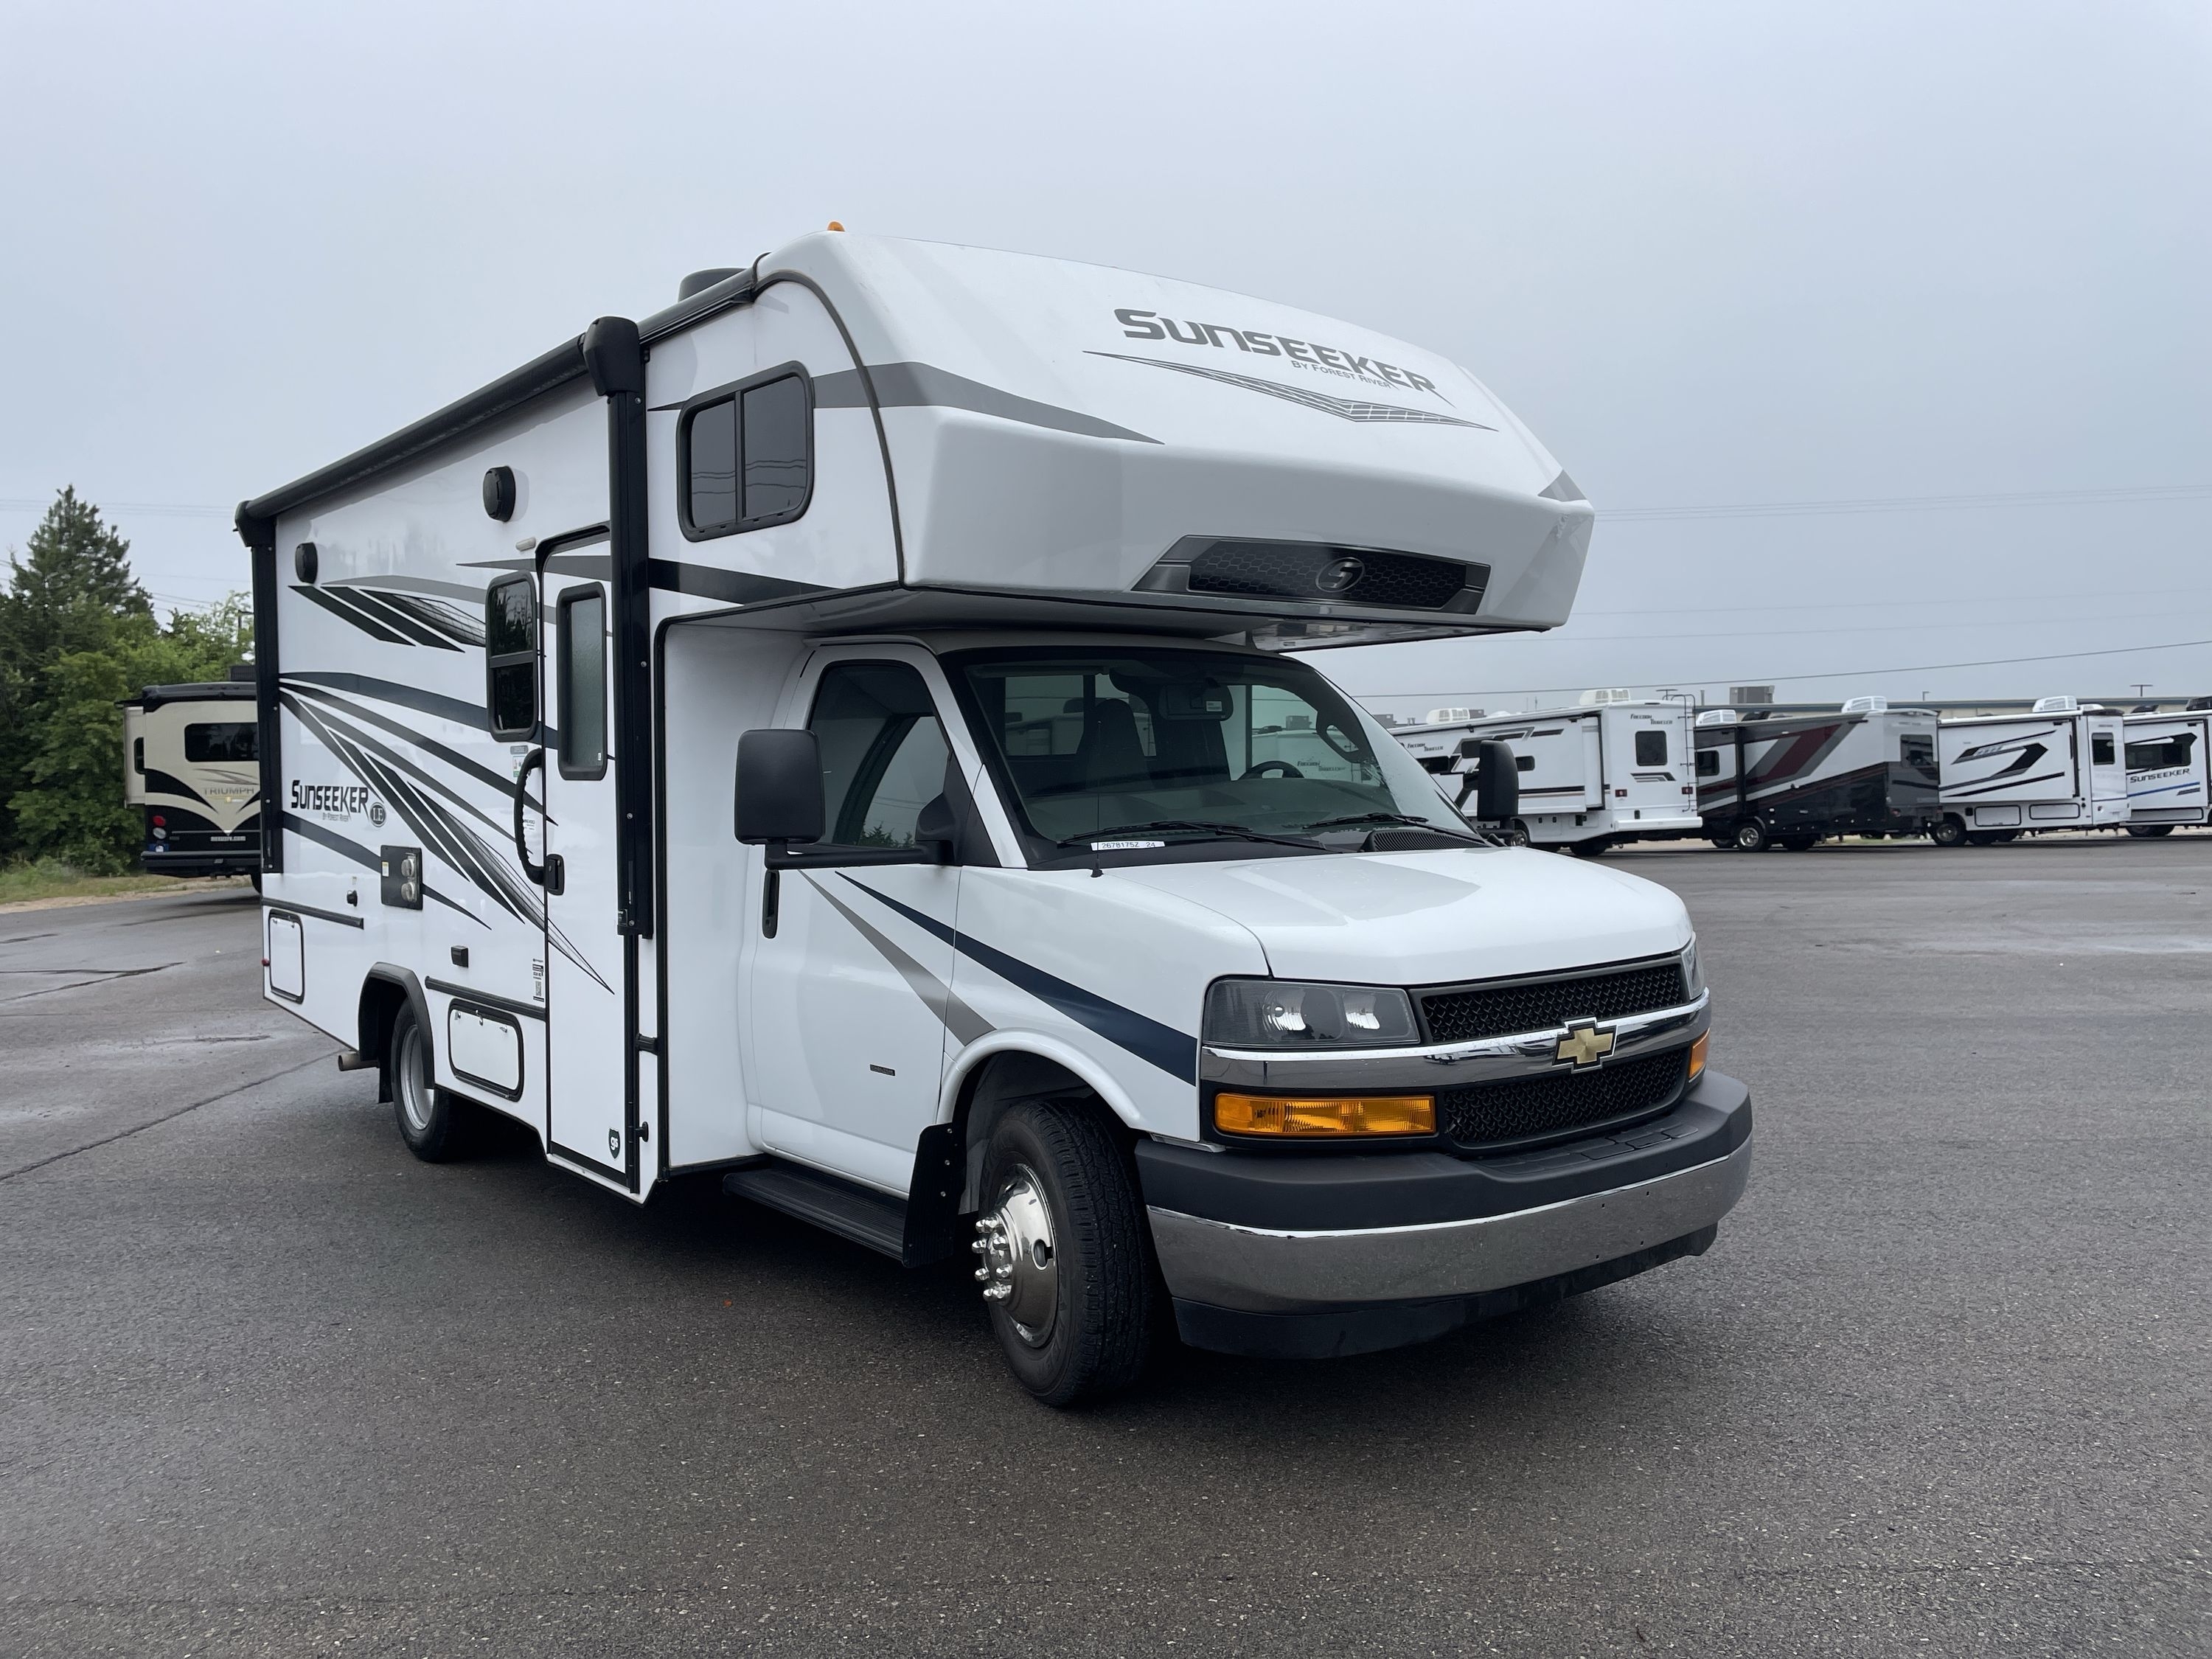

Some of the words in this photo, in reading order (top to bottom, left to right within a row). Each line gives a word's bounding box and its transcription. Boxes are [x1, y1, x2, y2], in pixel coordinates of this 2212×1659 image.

[1291, 360, 1308, 369] BY
[1312, 364, 1357, 380] FOREST
[372, 807, 383, 821] LE
